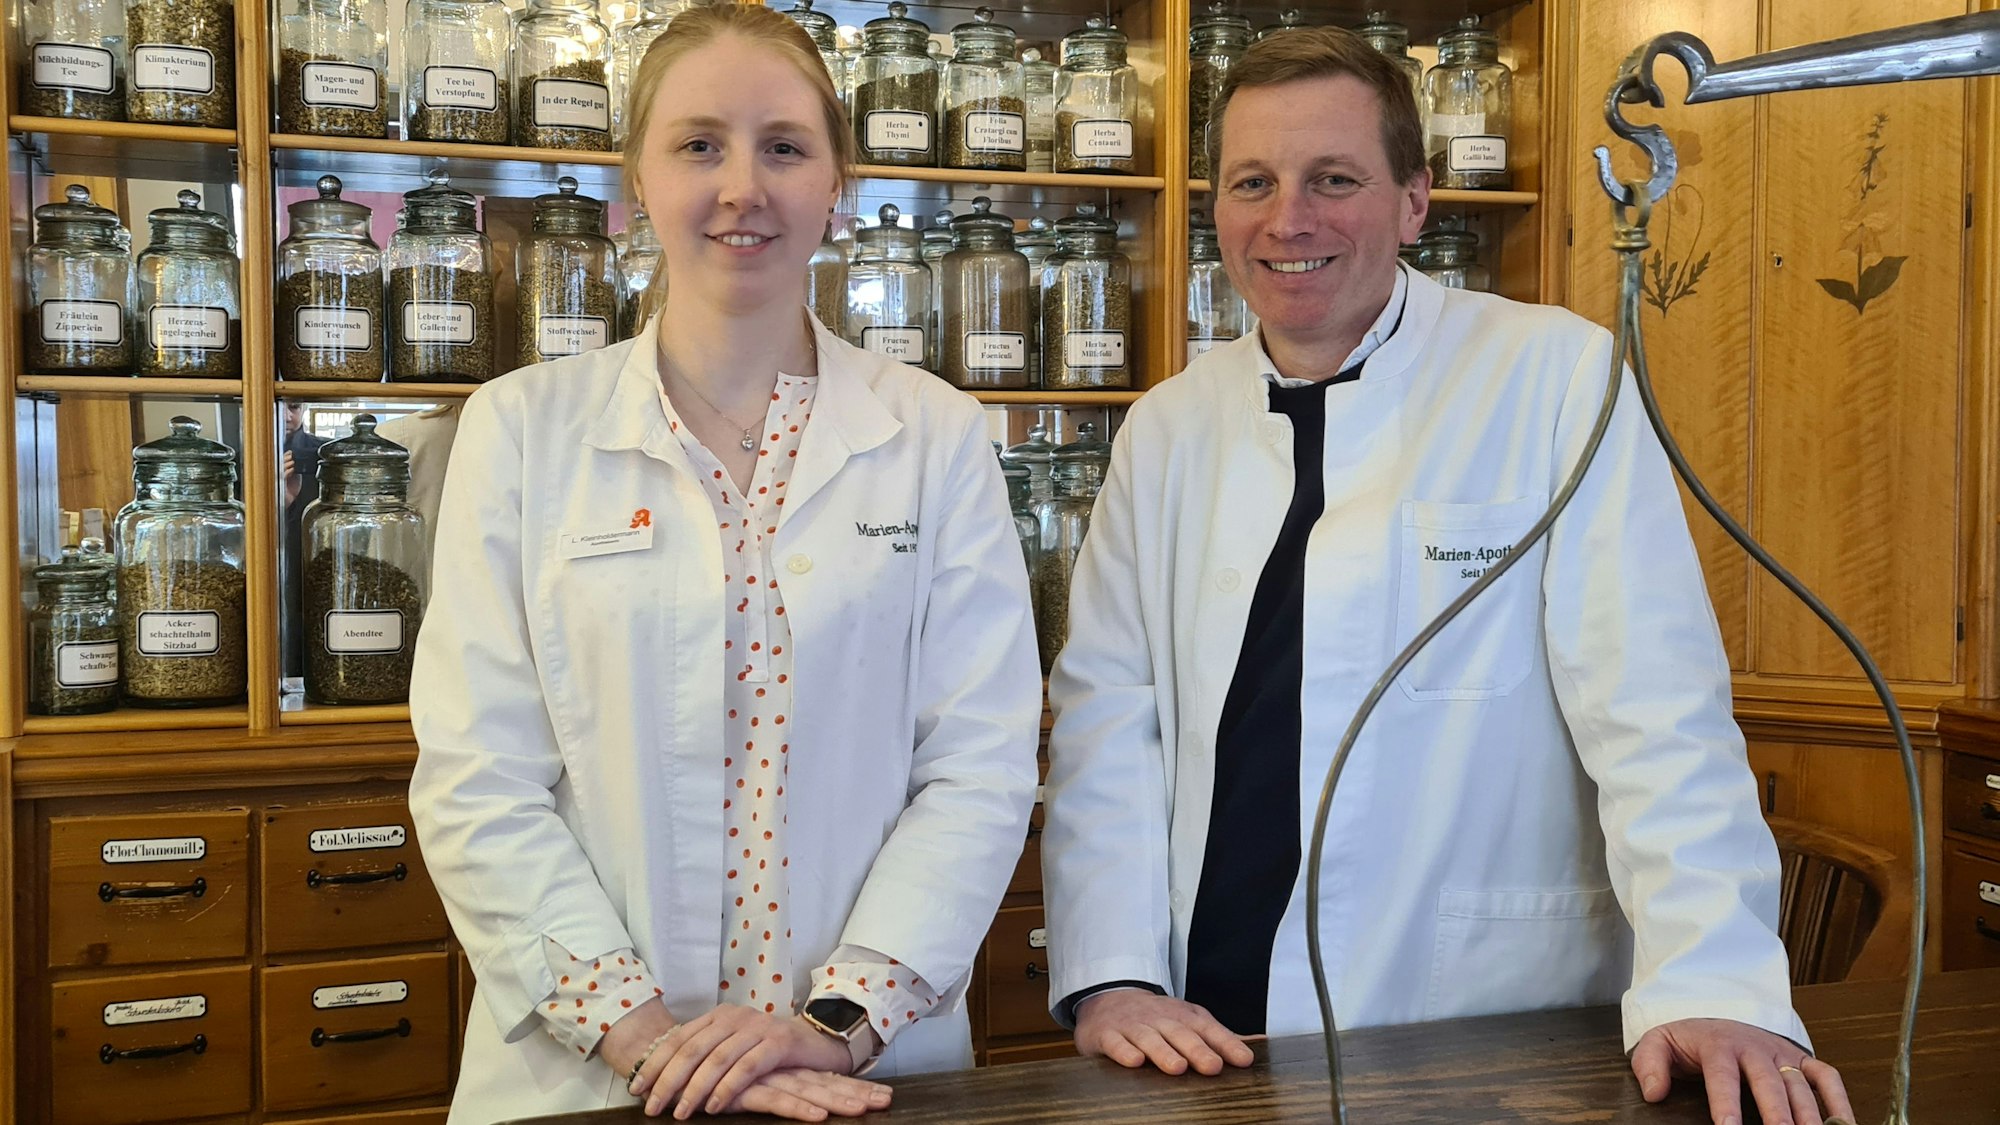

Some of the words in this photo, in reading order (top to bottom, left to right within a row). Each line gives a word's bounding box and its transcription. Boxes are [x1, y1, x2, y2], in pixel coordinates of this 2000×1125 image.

[37, 55, 104, 69] Milchbildungs-
[145, 55, 207, 68] Klimakterium
[61, 67, 78, 77] Tee
[163, 67, 180, 76] Tee
[314, 74, 347, 85] Magen-
[349, 76, 365, 85] und
[445, 77, 461, 86] Tee
[462, 78, 475, 87] bei
[322, 85, 359, 96] Darmtee
[435, 88, 485, 100] Verstopfung
[542, 96, 551, 104] In
[553, 96, 568, 105] der
[570, 97, 593, 108] Regel
[594, 101, 604, 110] gut
[886, 121, 909, 129] Herba
[885, 131, 910, 140] Thymi
[1094, 129, 1116, 137] Herba
[1470, 144, 1490, 152] Herba
[60, 311, 98, 321] Fräulein
[417, 313, 444, 321] Leber-
[446, 313, 462, 322] und
[167, 317, 207, 327] Herzens-
[304, 320, 361, 330] Kinderwunsch
[55, 322, 103, 332] Zipperlein
[420, 324, 458, 332] Gallentee
[547, 327, 597, 336] Stoffwechsel-
[325, 331, 340, 339] Tee
[566, 338, 580, 346] Tee
[882, 336, 910, 345] Fructus
[885, 346, 906, 354] Carvi
[983, 342, 1010, 350] Fructus
[892, 543, 908, 553] Seit
[1461, 569, 1480, 579] Seit
[165, 620, 196, 628] Acker-
[149, 630, 211, 638] schachtelhalm
[343, 629, 383, 638] Abendtee
